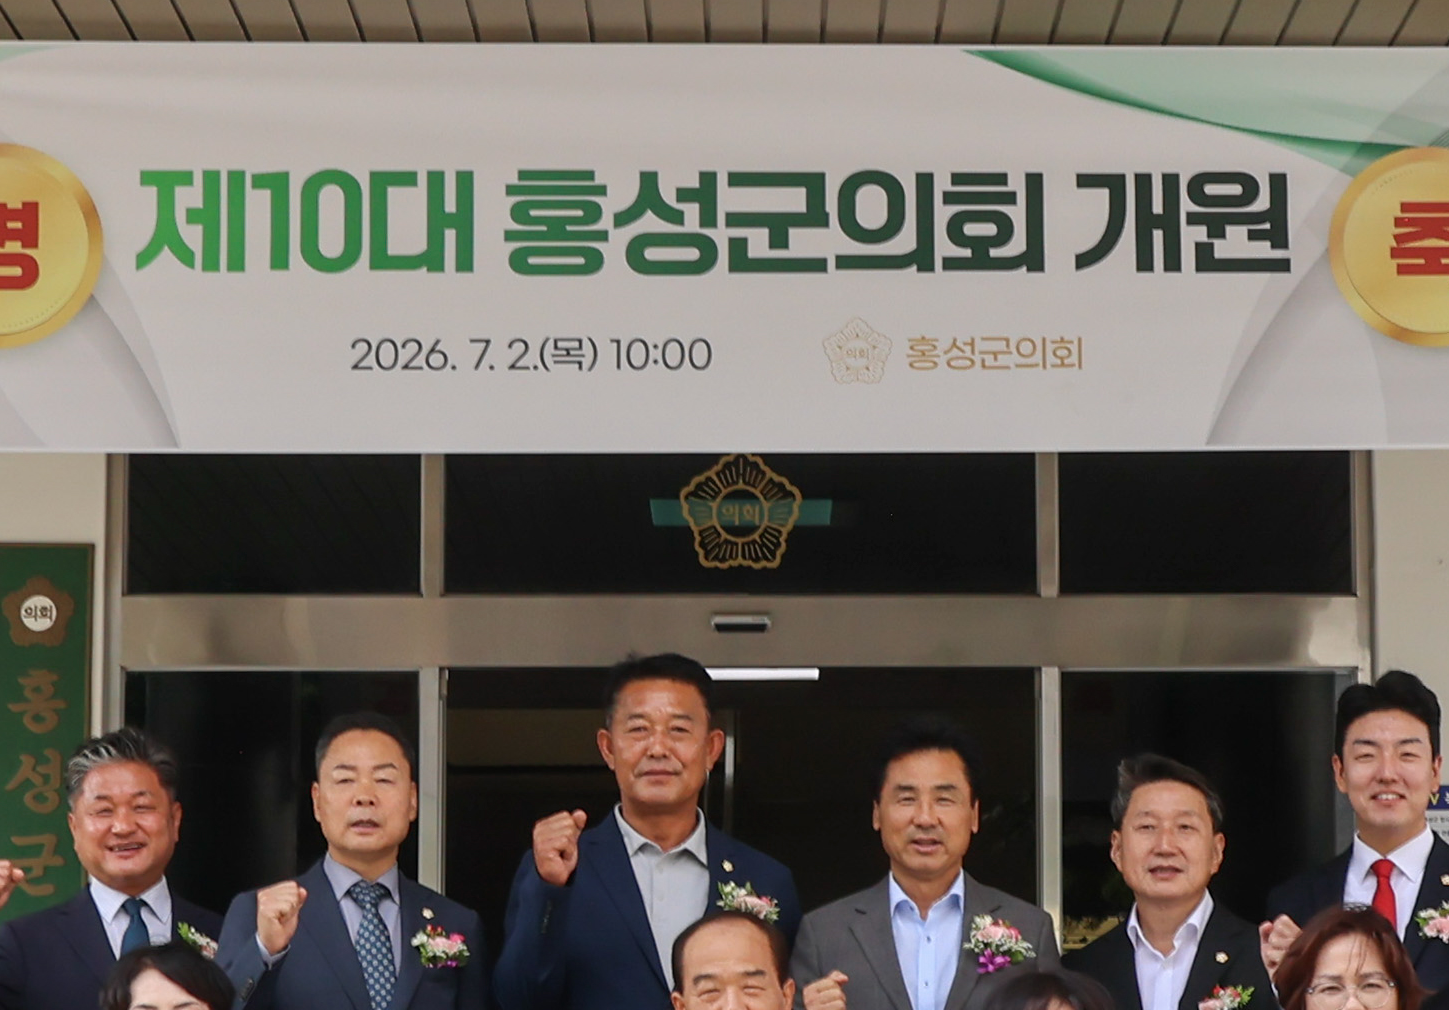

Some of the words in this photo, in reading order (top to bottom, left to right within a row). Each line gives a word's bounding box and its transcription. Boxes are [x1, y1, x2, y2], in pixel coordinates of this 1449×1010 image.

[137, 170, 475, 274] 제10대
[504, 169, 1045, 276] 홍성군의회
[1075, 172, 1292, 274] 개원
[350, 337, 457, 371] 2026.
[469, 338, 495, 371] 7.
[609, 337, 713, 371] 10:00
[906, 335, 1083, 371] 홍성군의회
[721, 503, 760, 526] 의회
[23, 604, 53, 622] 의회
